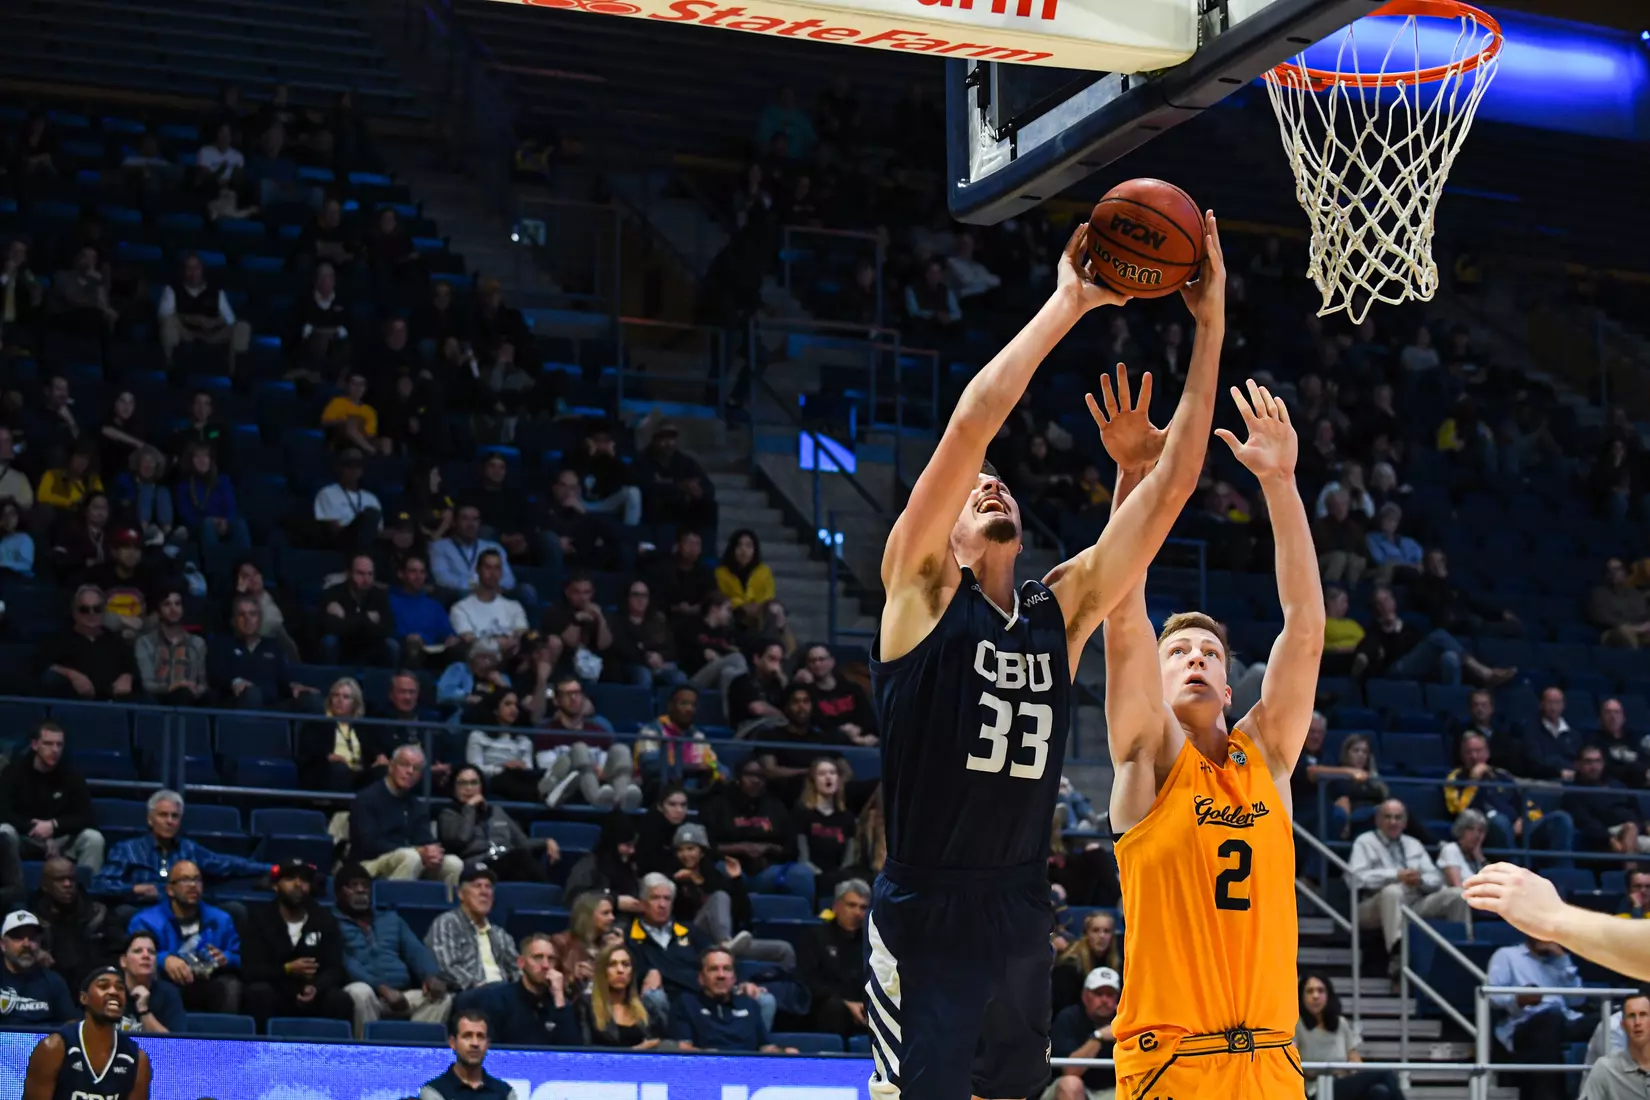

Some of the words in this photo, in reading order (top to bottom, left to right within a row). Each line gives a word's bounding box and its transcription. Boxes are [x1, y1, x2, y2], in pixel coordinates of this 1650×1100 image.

[647, 0, 861, 40] State
[853, 29, 1054, 62] Farm
[1110, 212, 1168, 251] NCAA
[1093, 240, 1163, 286] Wilson
[1023, 591, 1050, 608] WAC
[973, 639, 1053, 692] CBU
[966, 691, 1053, 780] 33
[1214, 839, 1253, 911] 2
